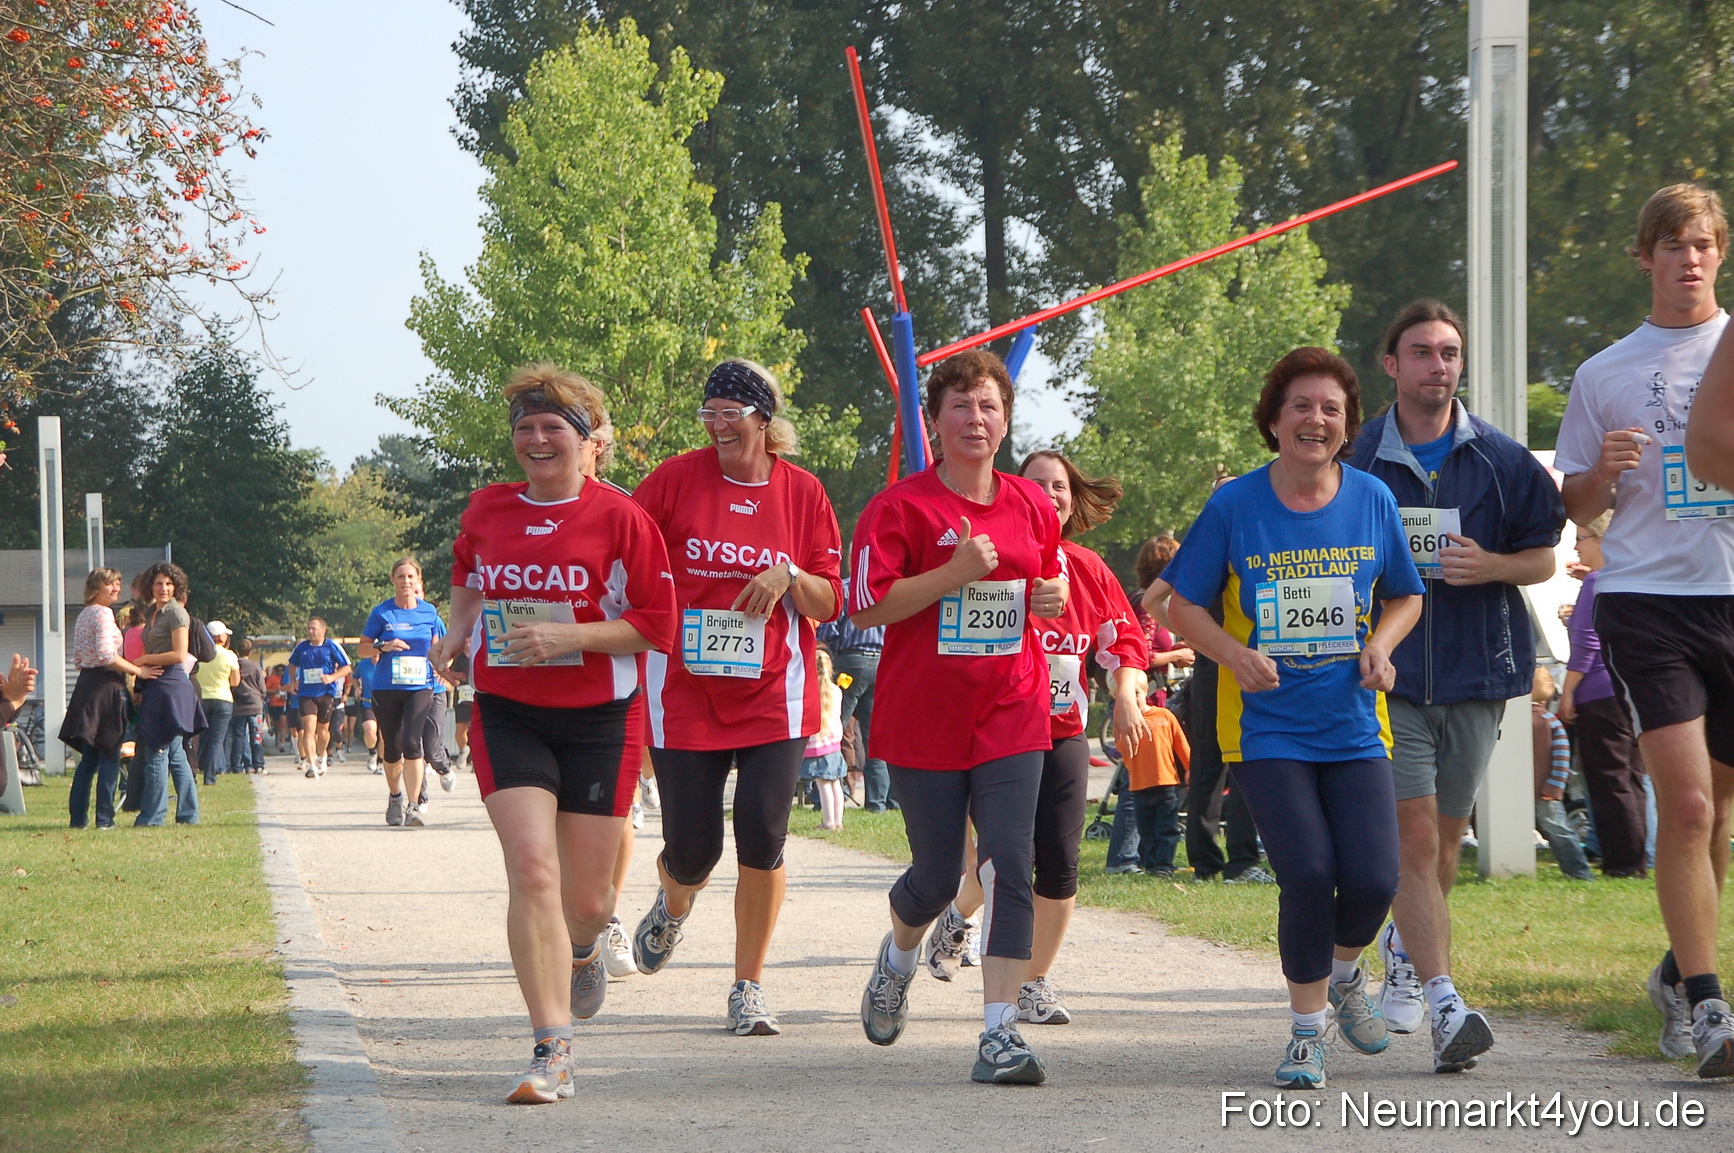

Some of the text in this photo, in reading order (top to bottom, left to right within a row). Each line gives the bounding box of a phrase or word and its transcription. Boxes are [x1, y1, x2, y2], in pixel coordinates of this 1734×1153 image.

[1654, 420, 1687, 434] 9. Ne
[730, 503, 753, 516] PUMA
[1399, 513, 1432, 527] anuel
[526, 525, 554, 536] PUMA
[936, 539, 959, 547] adida
[686, 537, 791, 569] SYSCAD
[1245, 546, 1376, 570] 10. NEUMARKTER
[478, 564, 590, 591] SYSCAD
[687, 567, 755, 581] www.metallbau
[1266, 562, 1359, 582] STADTLAUF
[968, 587, 1015, 602] Roswitha
[1283, 586, 1312, 600] Betti
[506, 601, 535, 616] Karin
[490, 619, 497, 630] D
[706, 615, 744, 630] Brigitte
[947, 607, 1017, 629] D 2300
[1263, 606, 1345, 629] D 2646
[688, 632, 755, 654] D 2773
[1032, 628, 1091, 655] CAD
[1318, 640, 1355, 649] PFLEIDERER
[1051, 680, 1070, 697] 54
